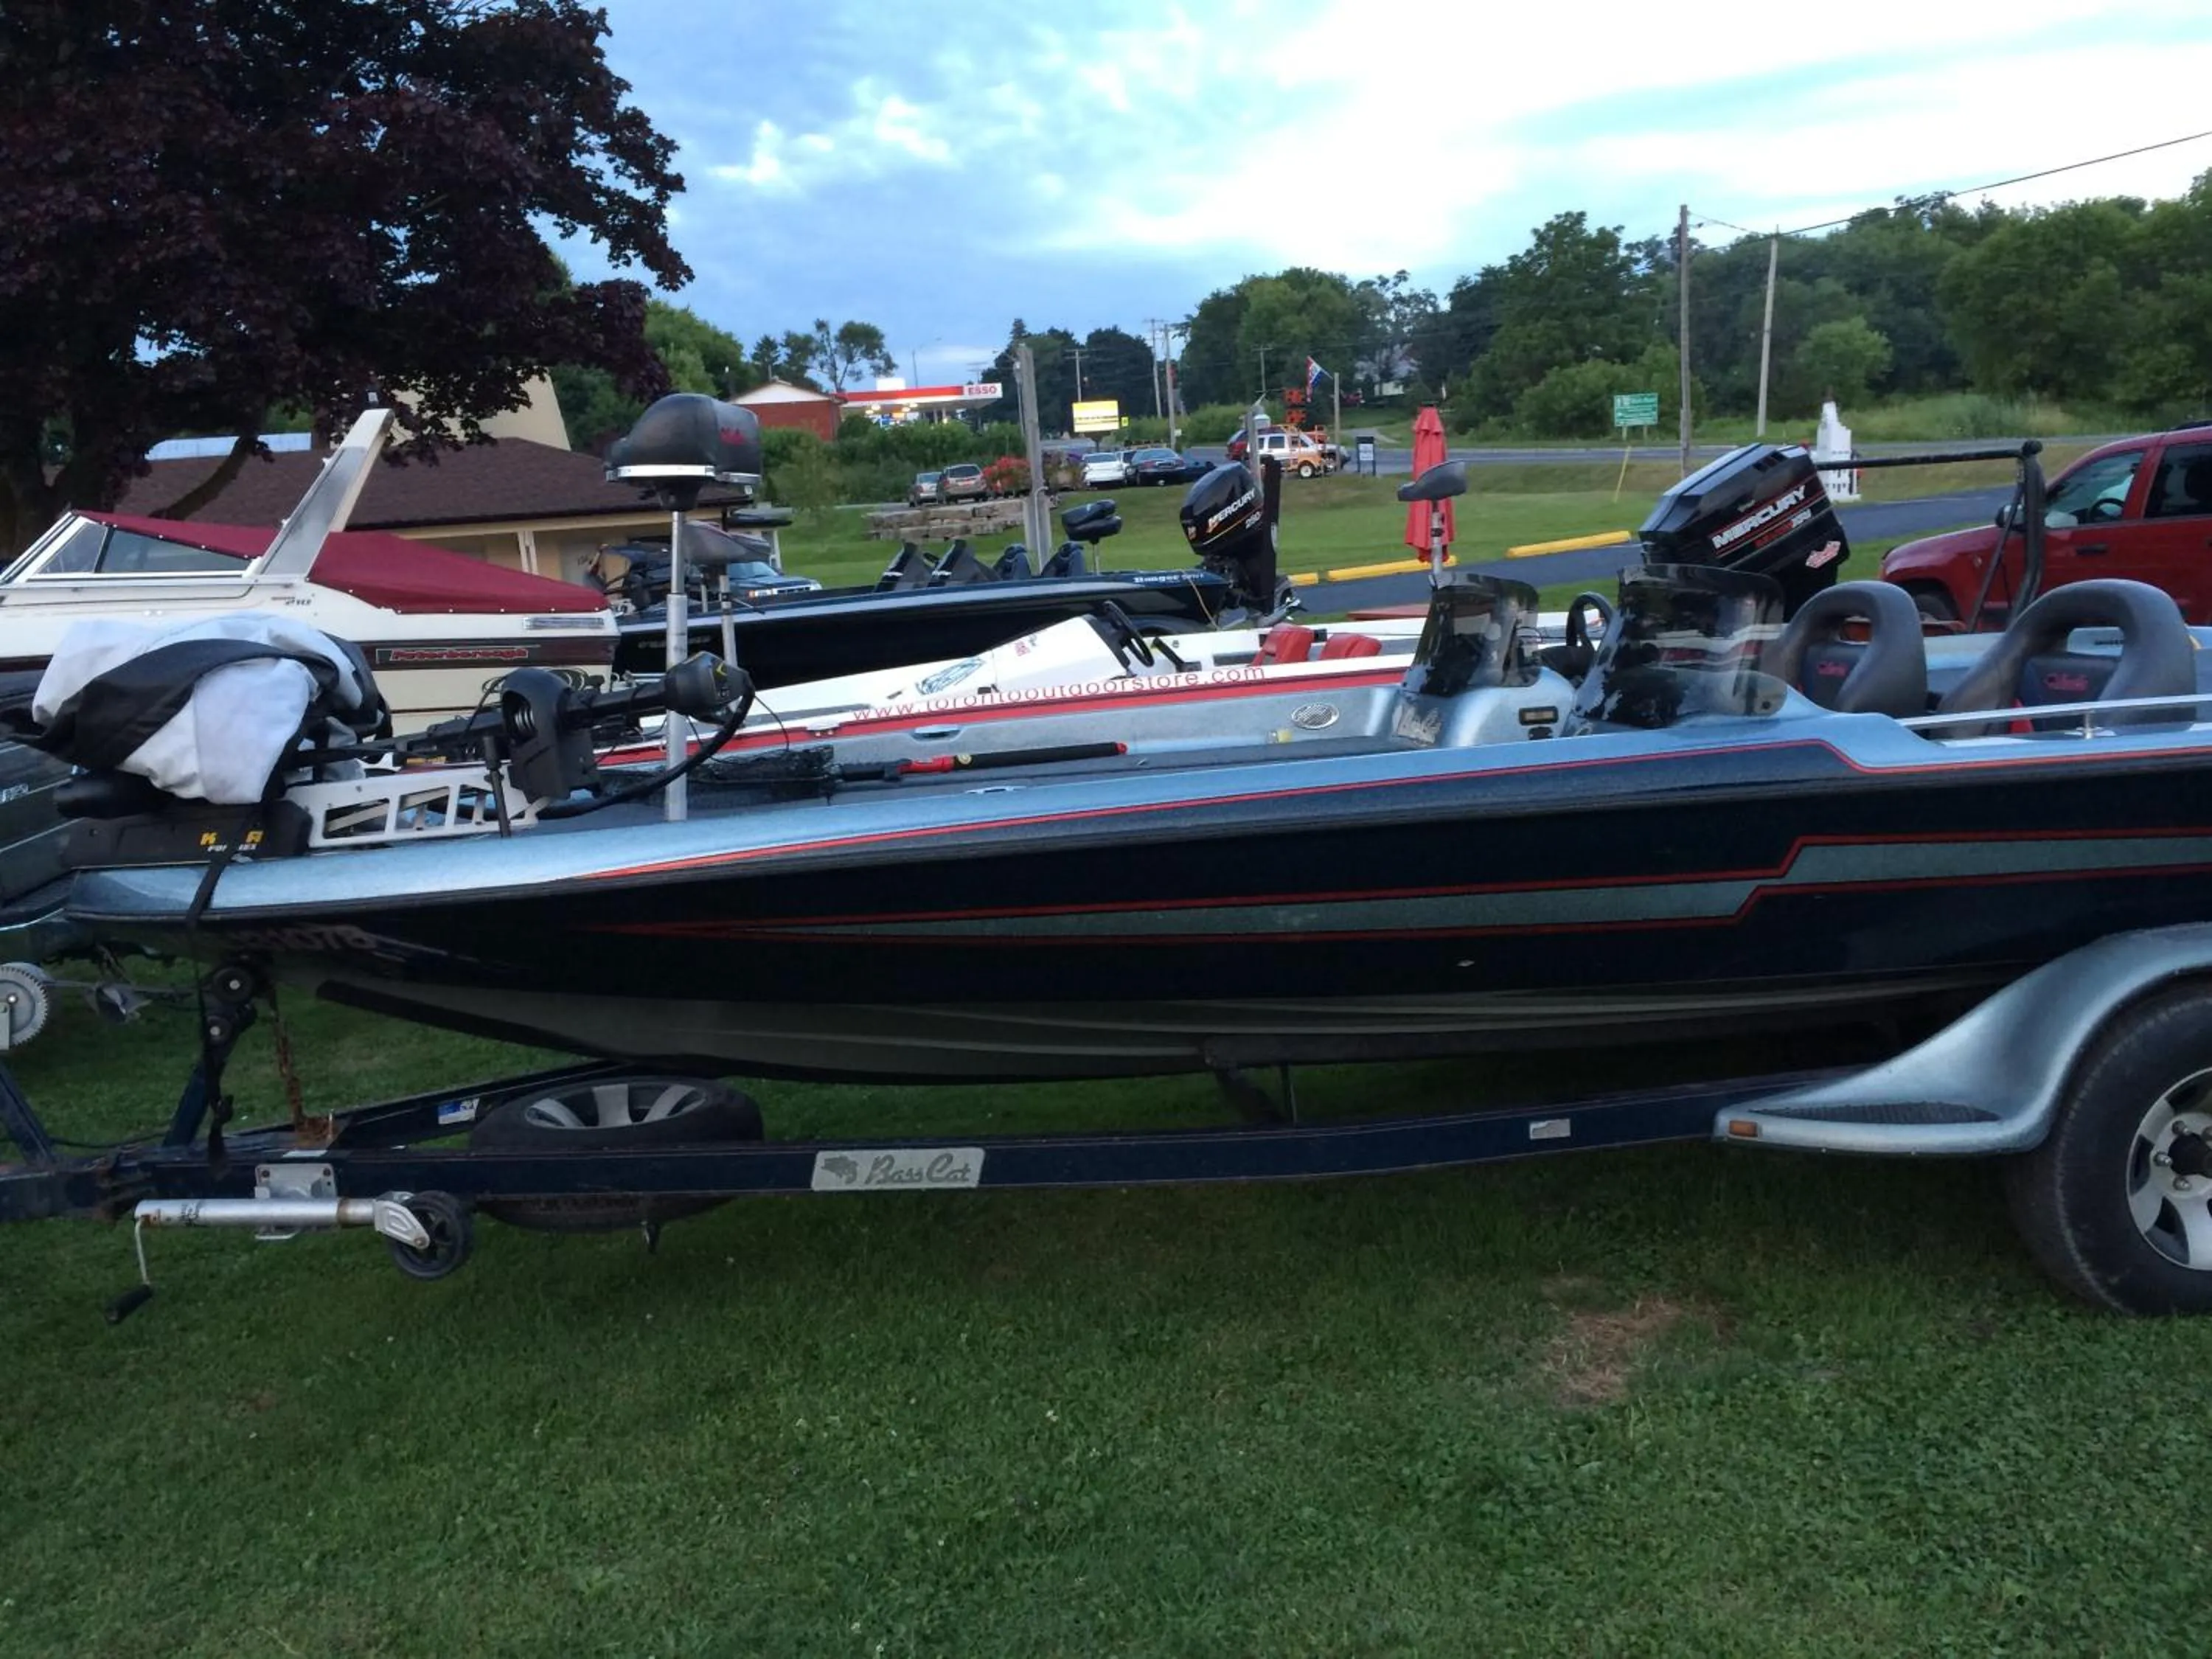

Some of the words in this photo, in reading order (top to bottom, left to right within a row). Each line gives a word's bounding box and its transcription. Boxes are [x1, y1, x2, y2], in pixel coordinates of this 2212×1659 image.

[968, 386, 997, 396] ESSO
[1206, 487, 1256, 534] MERCURY
[1711, 484, 1806, 549] MERCURY
[864, 1154, 922, 1185] Bass
[926, 1152, 971, 1183] Cat
